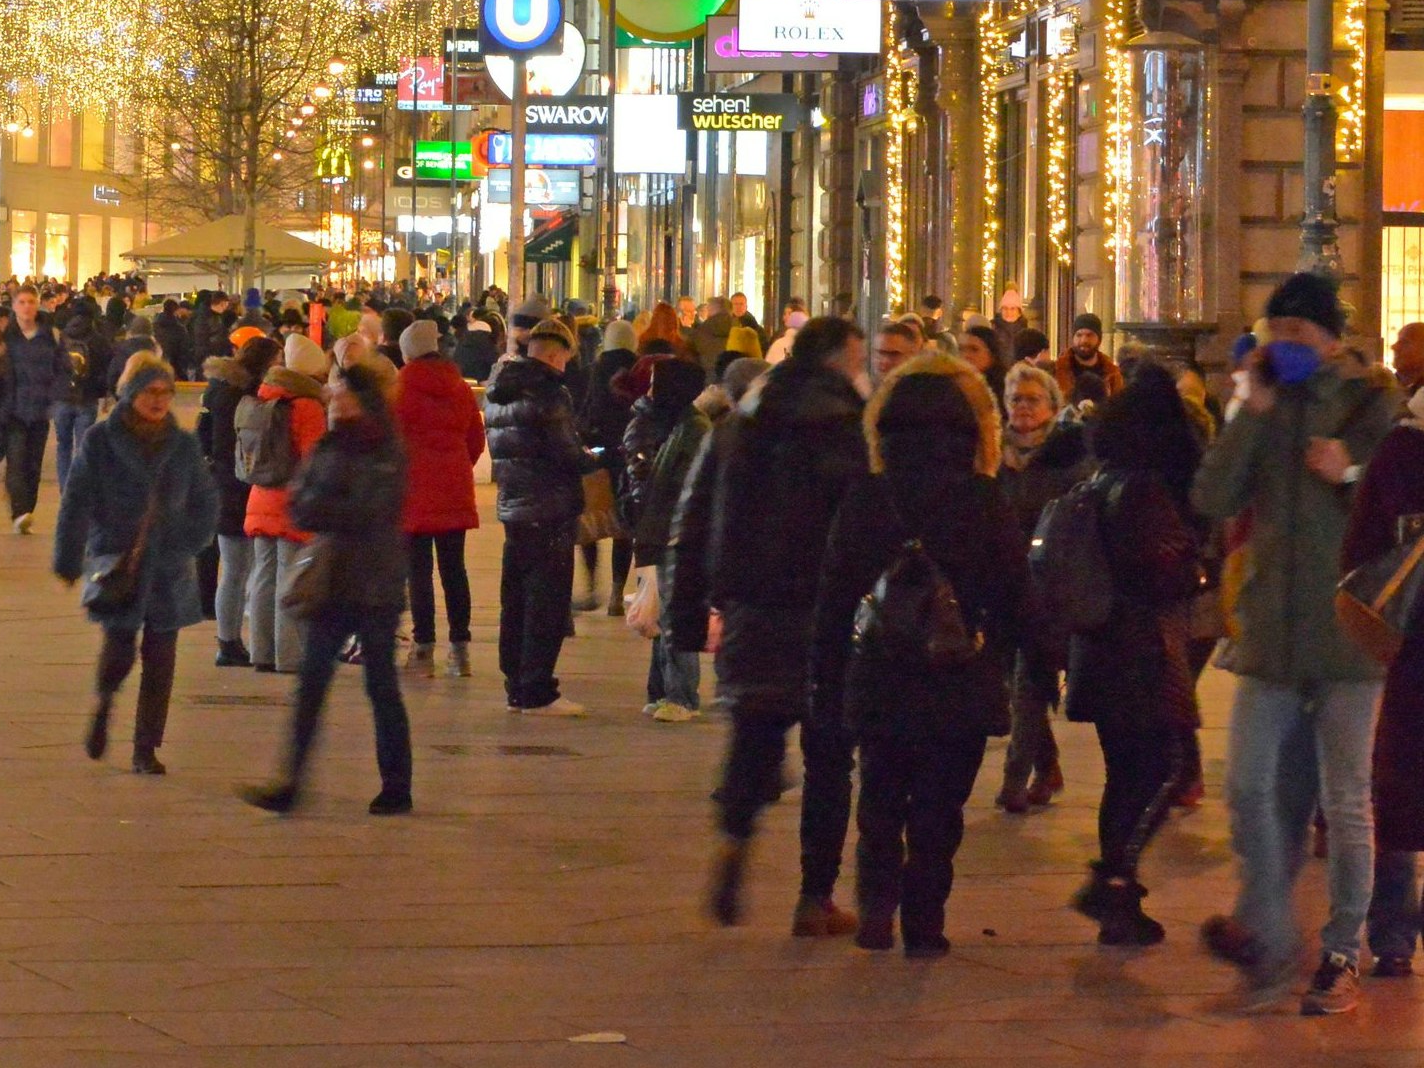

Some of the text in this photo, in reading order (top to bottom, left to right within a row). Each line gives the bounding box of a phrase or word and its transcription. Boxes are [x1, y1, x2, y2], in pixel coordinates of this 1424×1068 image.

[774, 25, 845, 41] ROLEX
[692, 95, 751, 113] sehen!
[525, 105, 609, 125] SWAROV
[692, 113, 783, 130] wutscher
